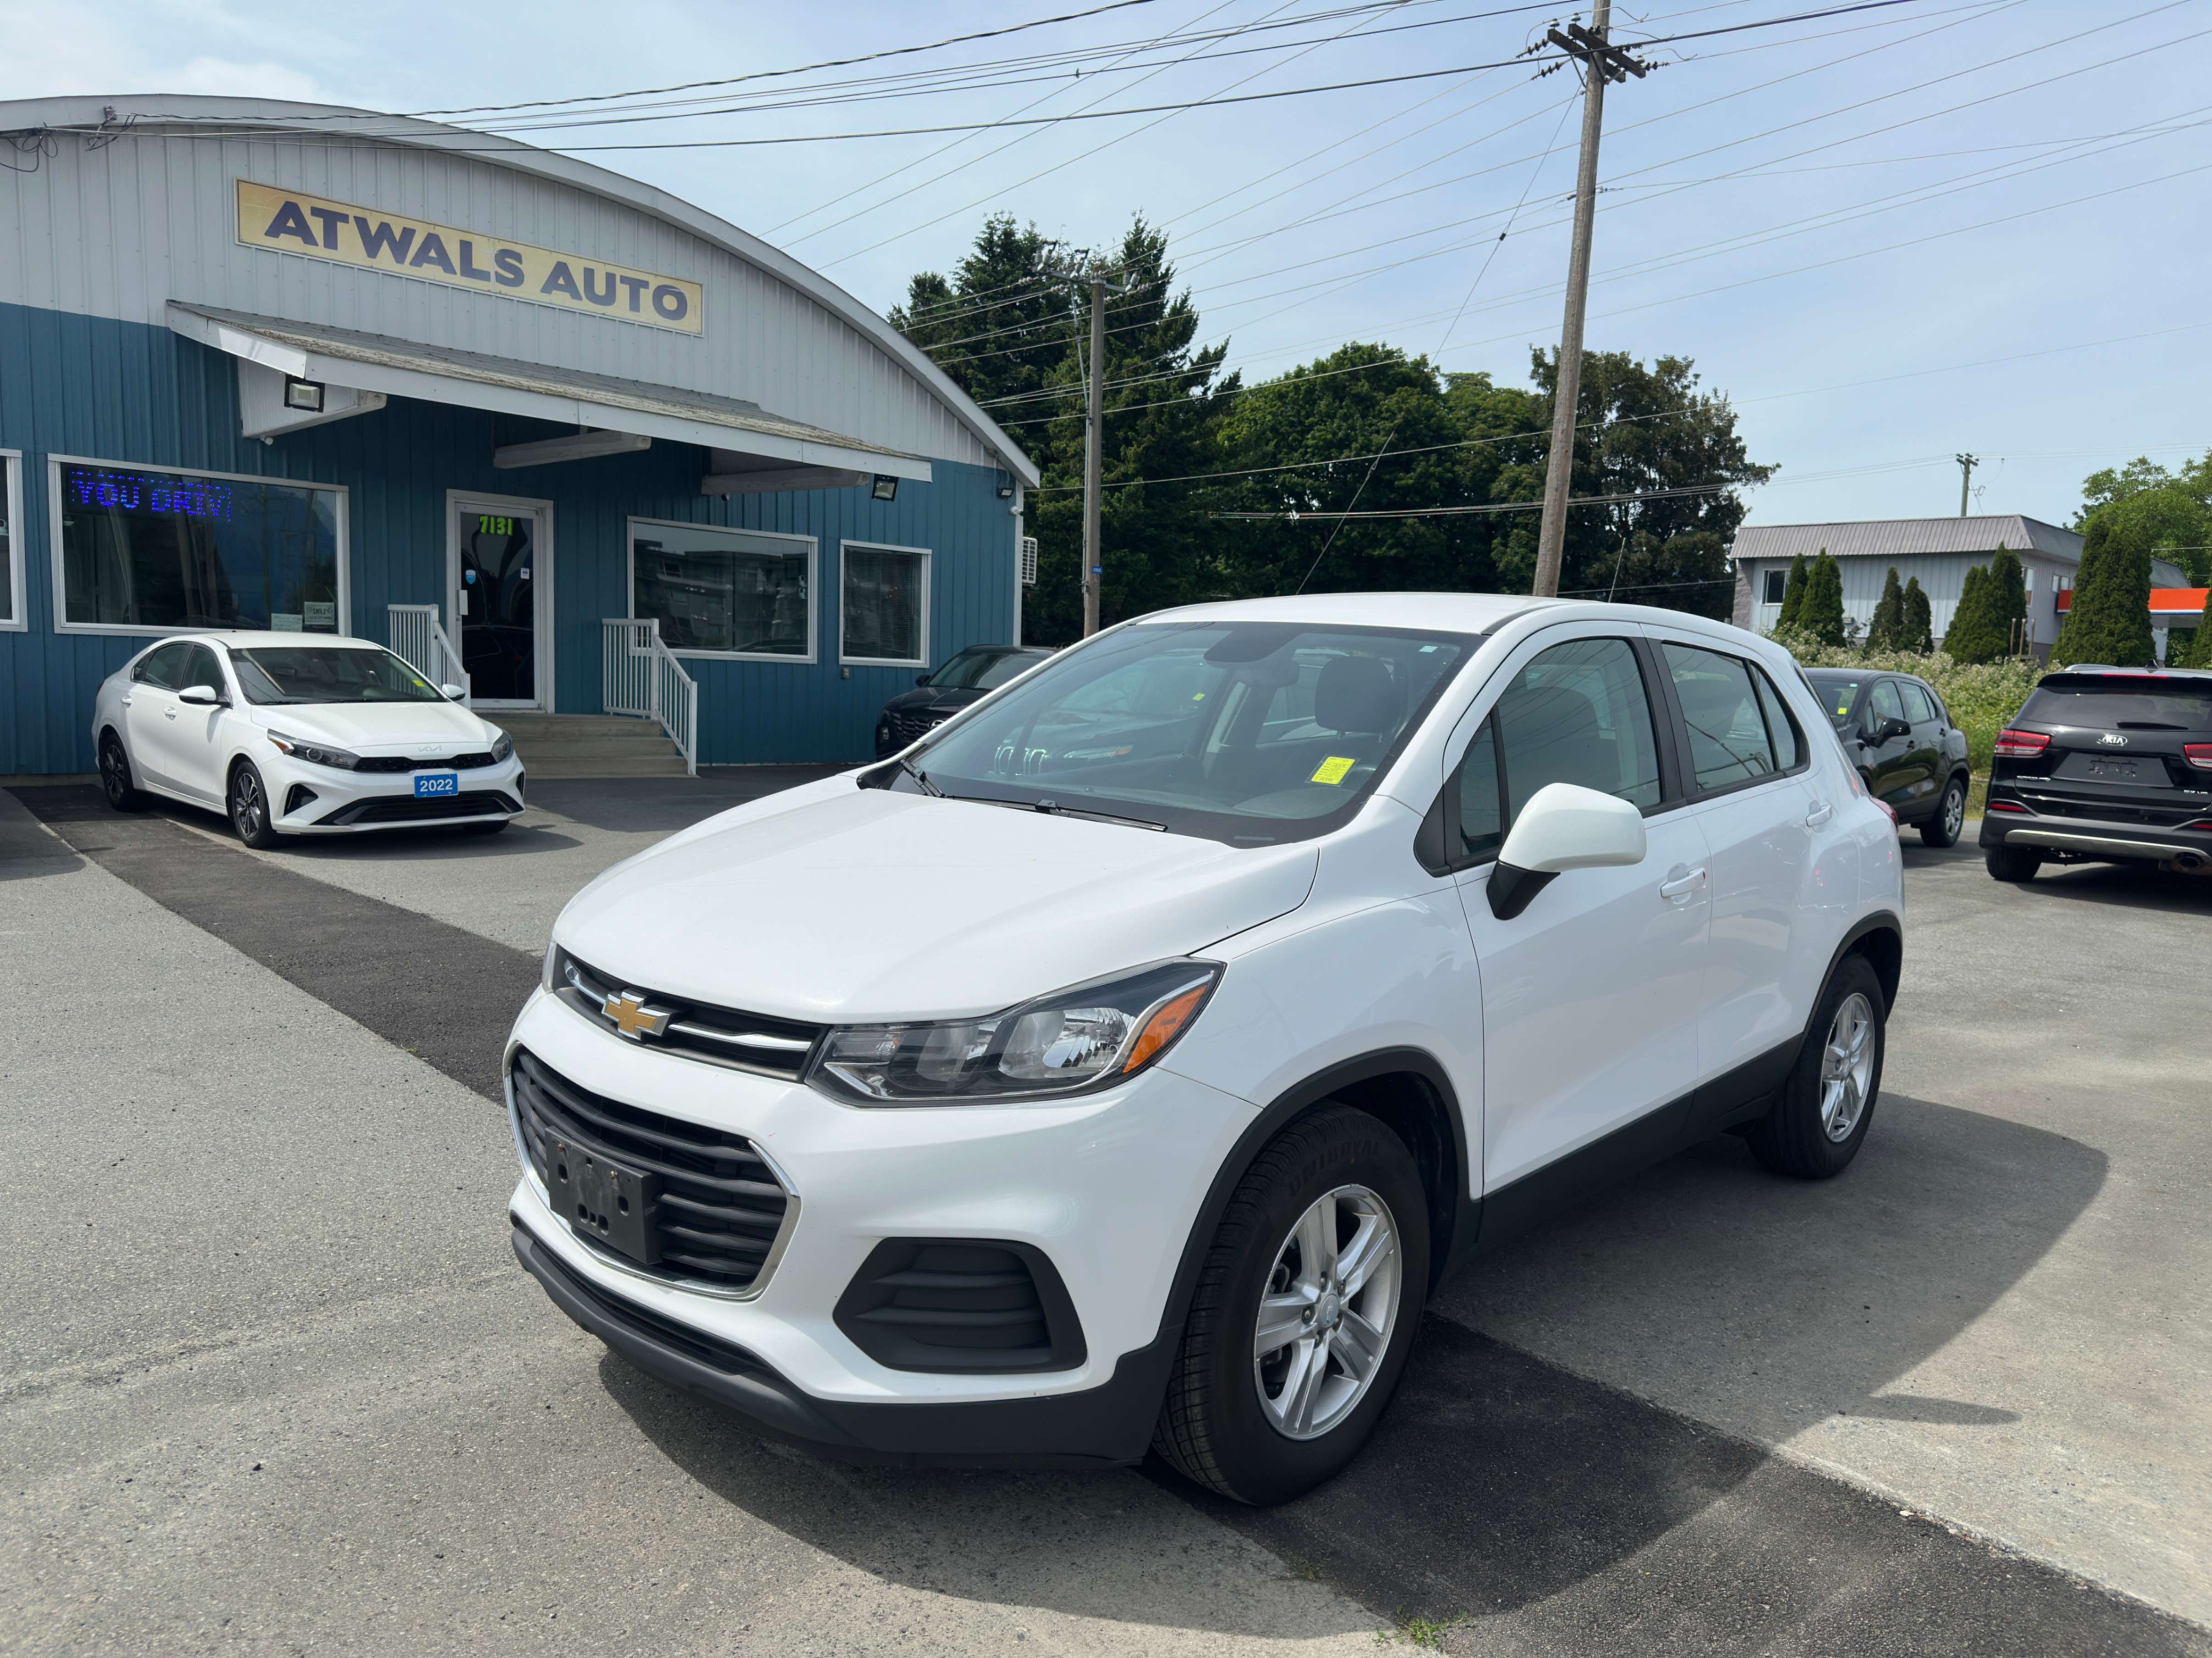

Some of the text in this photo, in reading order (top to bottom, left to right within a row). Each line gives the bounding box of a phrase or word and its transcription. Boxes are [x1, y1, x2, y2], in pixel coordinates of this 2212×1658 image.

[265, 201, 688, 320] ATWALS AUTO
[76, 480, 139, 509] YOU
[479, 516, 513, 536] 7131
[2106, 735, 2123, 745] KIA
[420, 779, 453, 792] 2022
